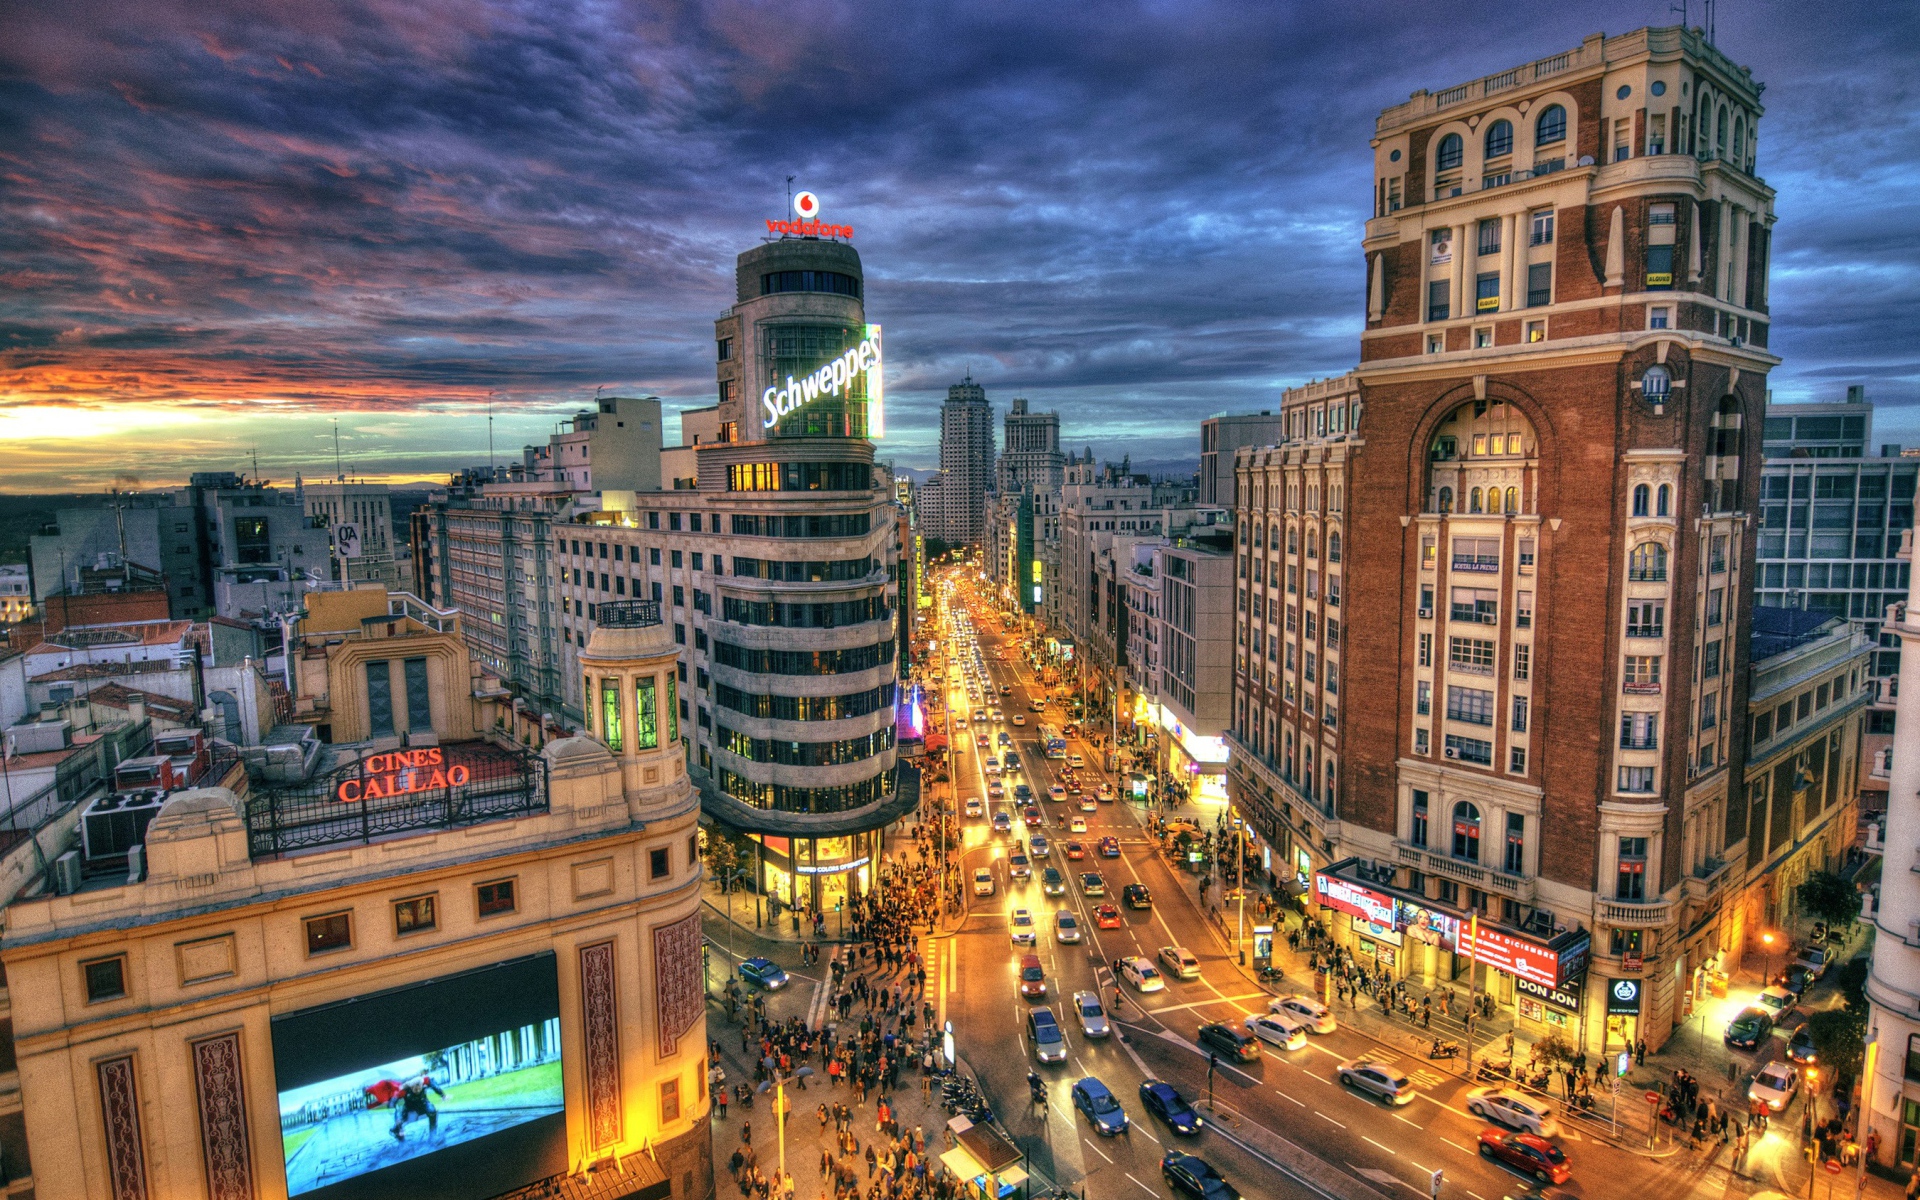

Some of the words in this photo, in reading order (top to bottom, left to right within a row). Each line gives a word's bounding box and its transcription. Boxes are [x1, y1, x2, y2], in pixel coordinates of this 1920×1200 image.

[765, 217, 854, 239] vodafone
[762, 331, 881, 428] Schweppes
[366, 747, 442, 774] CINES
[338, 765, 470, 802] CALLAO
[1489, 933, 1500, 941] DE
[1504, 938, 1555, 960] DICIEMBRE
[1518, 978, 1548, 997] DON
[1549, 990, 1577, 1008] JON
[1406, 1069, 1446, 1090] BUS
